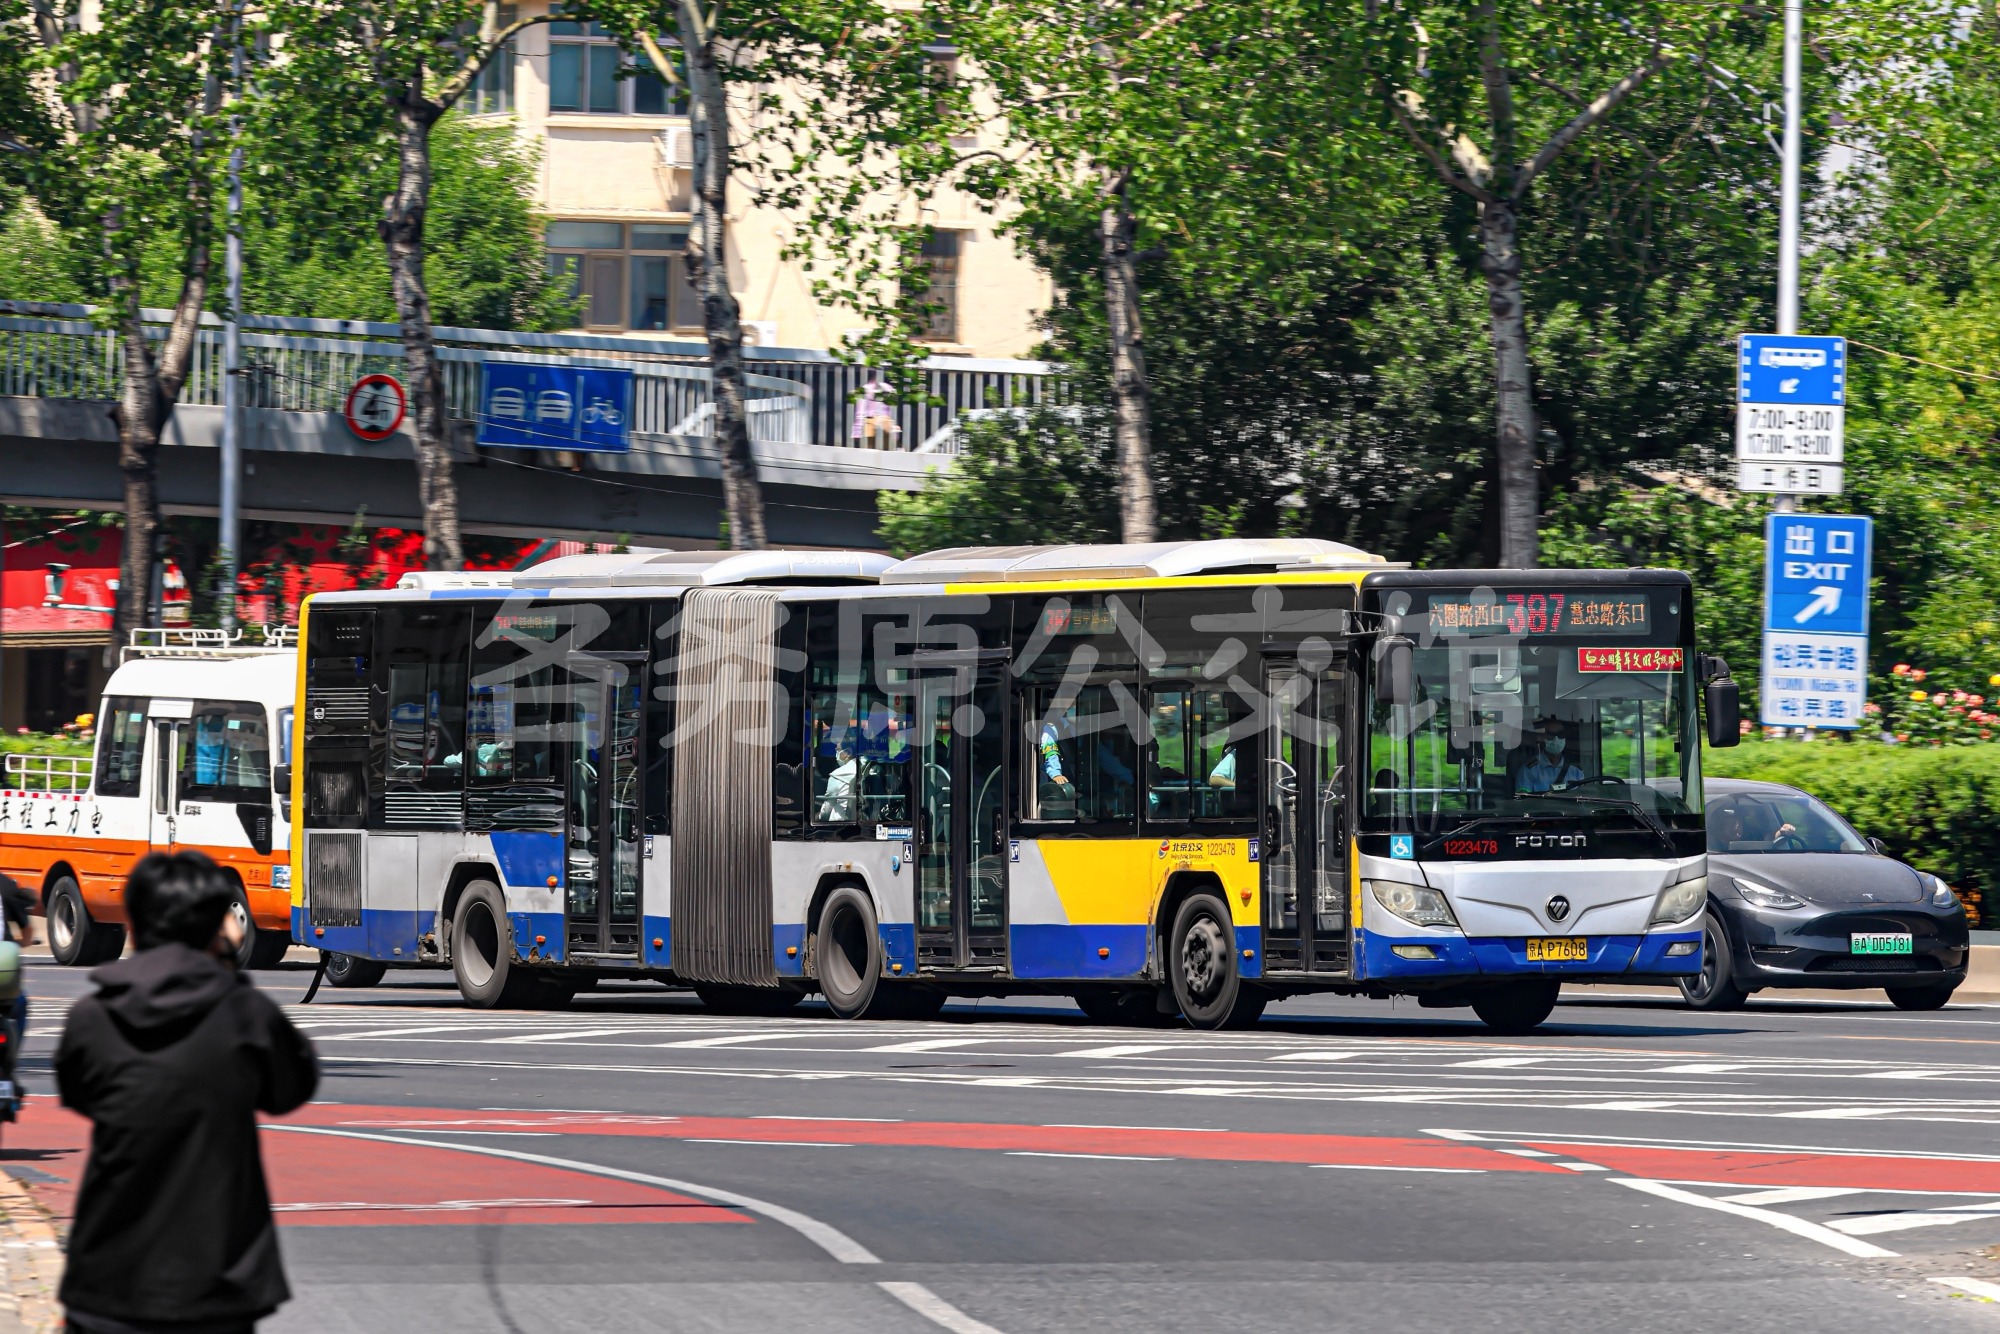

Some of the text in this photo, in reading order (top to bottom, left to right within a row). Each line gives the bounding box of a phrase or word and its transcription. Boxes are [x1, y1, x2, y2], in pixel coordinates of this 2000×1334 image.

[1762, 467, 1822, 489] 工作日
[1784, 525, 1855, 555] 出口
[1783, 561, 1852, 580] EXIT
[1429, 602, 1504, 627] 六圈路西口
[1506, 593, 1565, 633] 387
[1172, 842, 1236, 856] 北京公交 1223478
[1443, 835, 1587, 855] 1223478 FOTON
